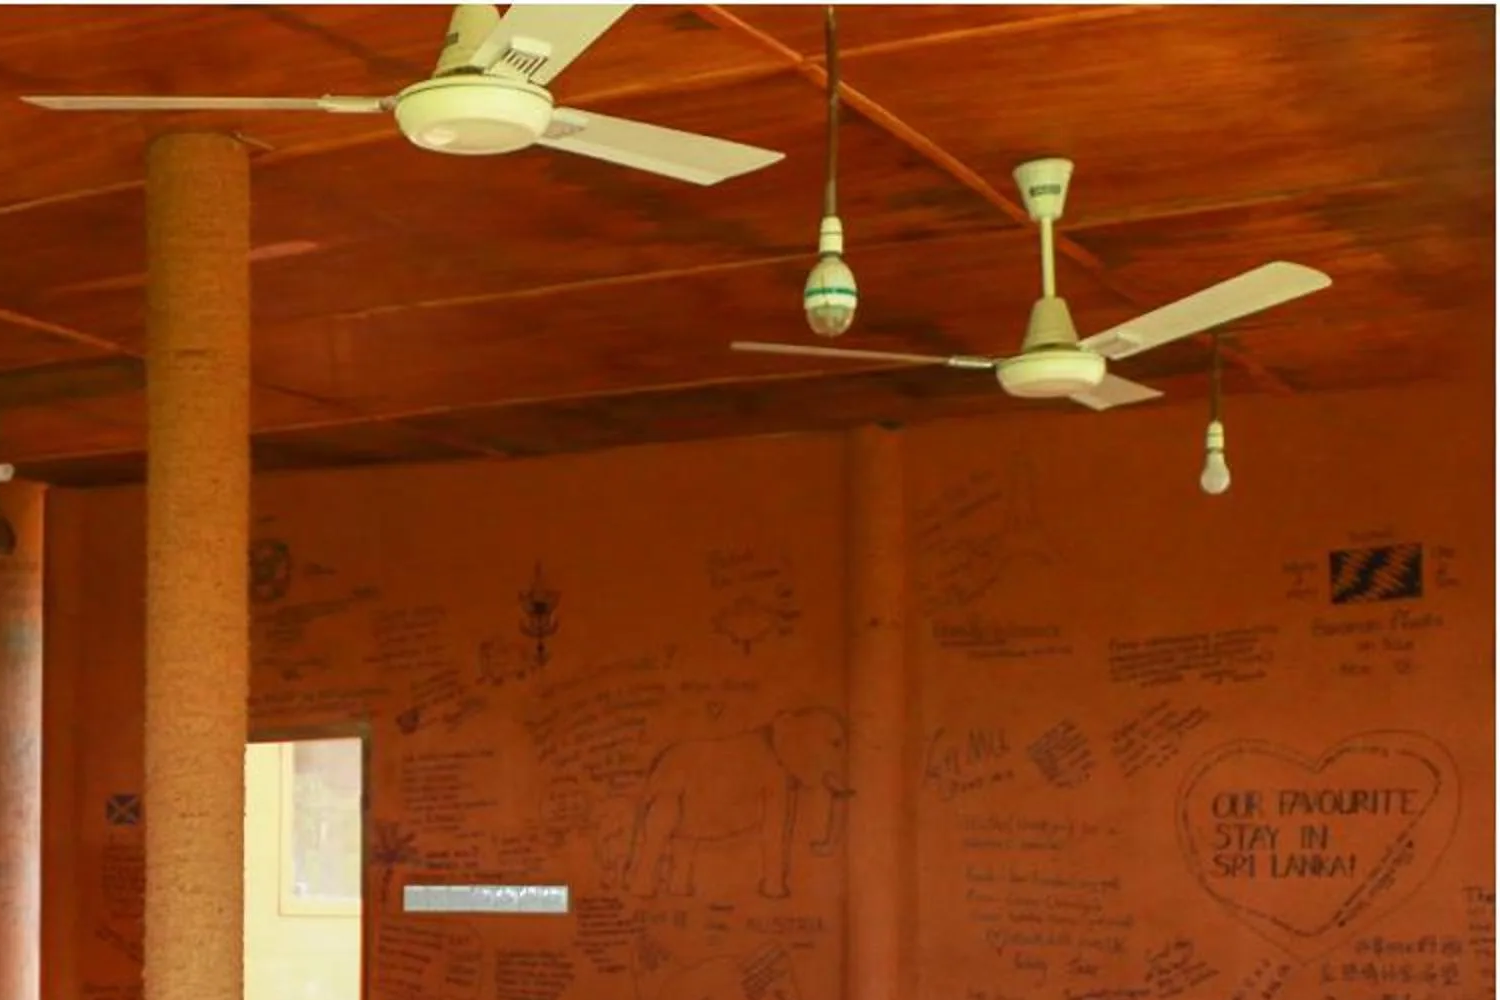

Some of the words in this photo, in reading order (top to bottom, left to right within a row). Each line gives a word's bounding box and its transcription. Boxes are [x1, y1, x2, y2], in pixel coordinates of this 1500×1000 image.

[1211, 790, 1264, 818] OUR
[1277, 788, 1419, 816] FAVOURITE
[1214, 823, 1279, 850] STAY
[1301, 824, 1329, 850] IN
[1212, 853, 1255, 879] SRI
[1271, 853, 1357, 879] LANKA!
